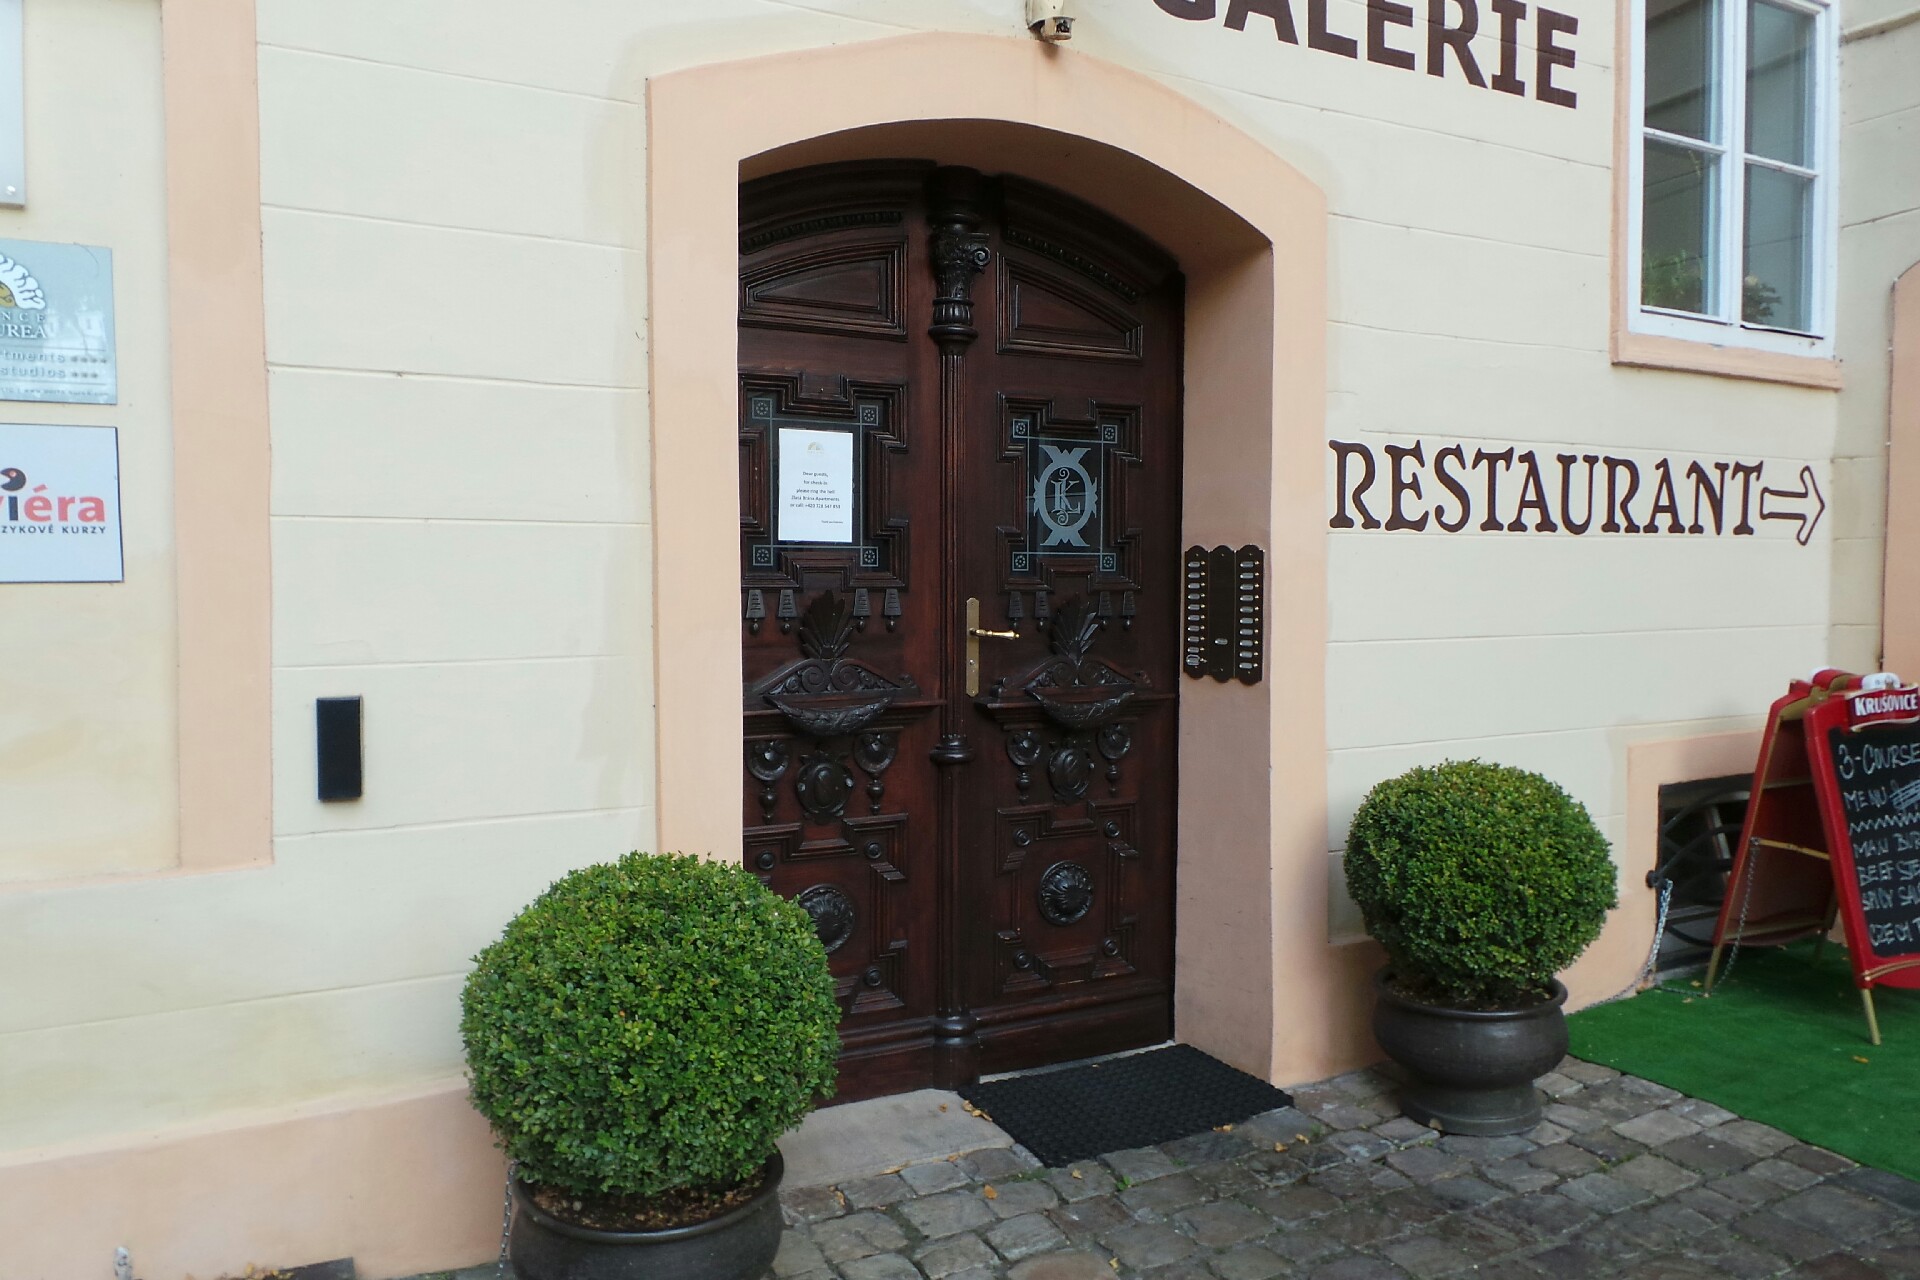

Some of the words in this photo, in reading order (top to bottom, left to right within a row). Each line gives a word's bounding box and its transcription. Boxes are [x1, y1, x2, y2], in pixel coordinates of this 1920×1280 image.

[0, 476, 106, 522] iéra
[1328, 438, 1765, 536] RESTAURANT
[62, 525, 107, 534] KURZY
[1854, 692, 1919, 716] KRUŠOVICE
[1842, 786, 1887, 812] MENU
